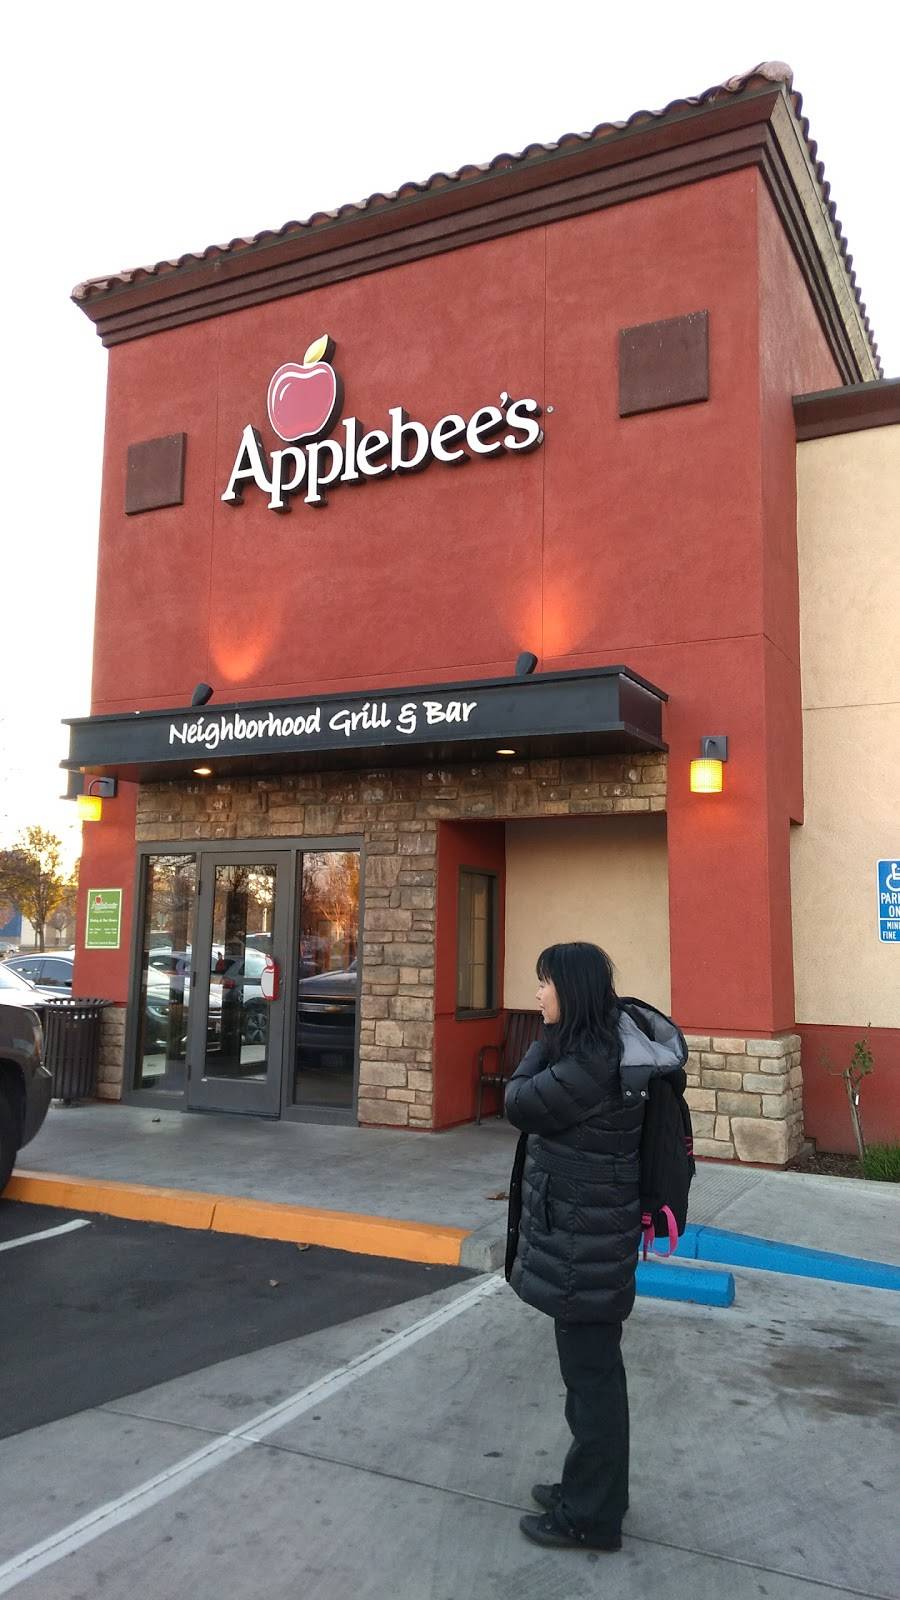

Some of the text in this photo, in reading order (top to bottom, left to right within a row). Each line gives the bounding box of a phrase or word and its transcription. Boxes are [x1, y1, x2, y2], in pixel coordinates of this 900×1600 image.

[221, 391, 540, 509] Applebee's
[168, 701, 478, 750] Neighborhood Grill & Bar
[882, 930, 897, 940] FINE
